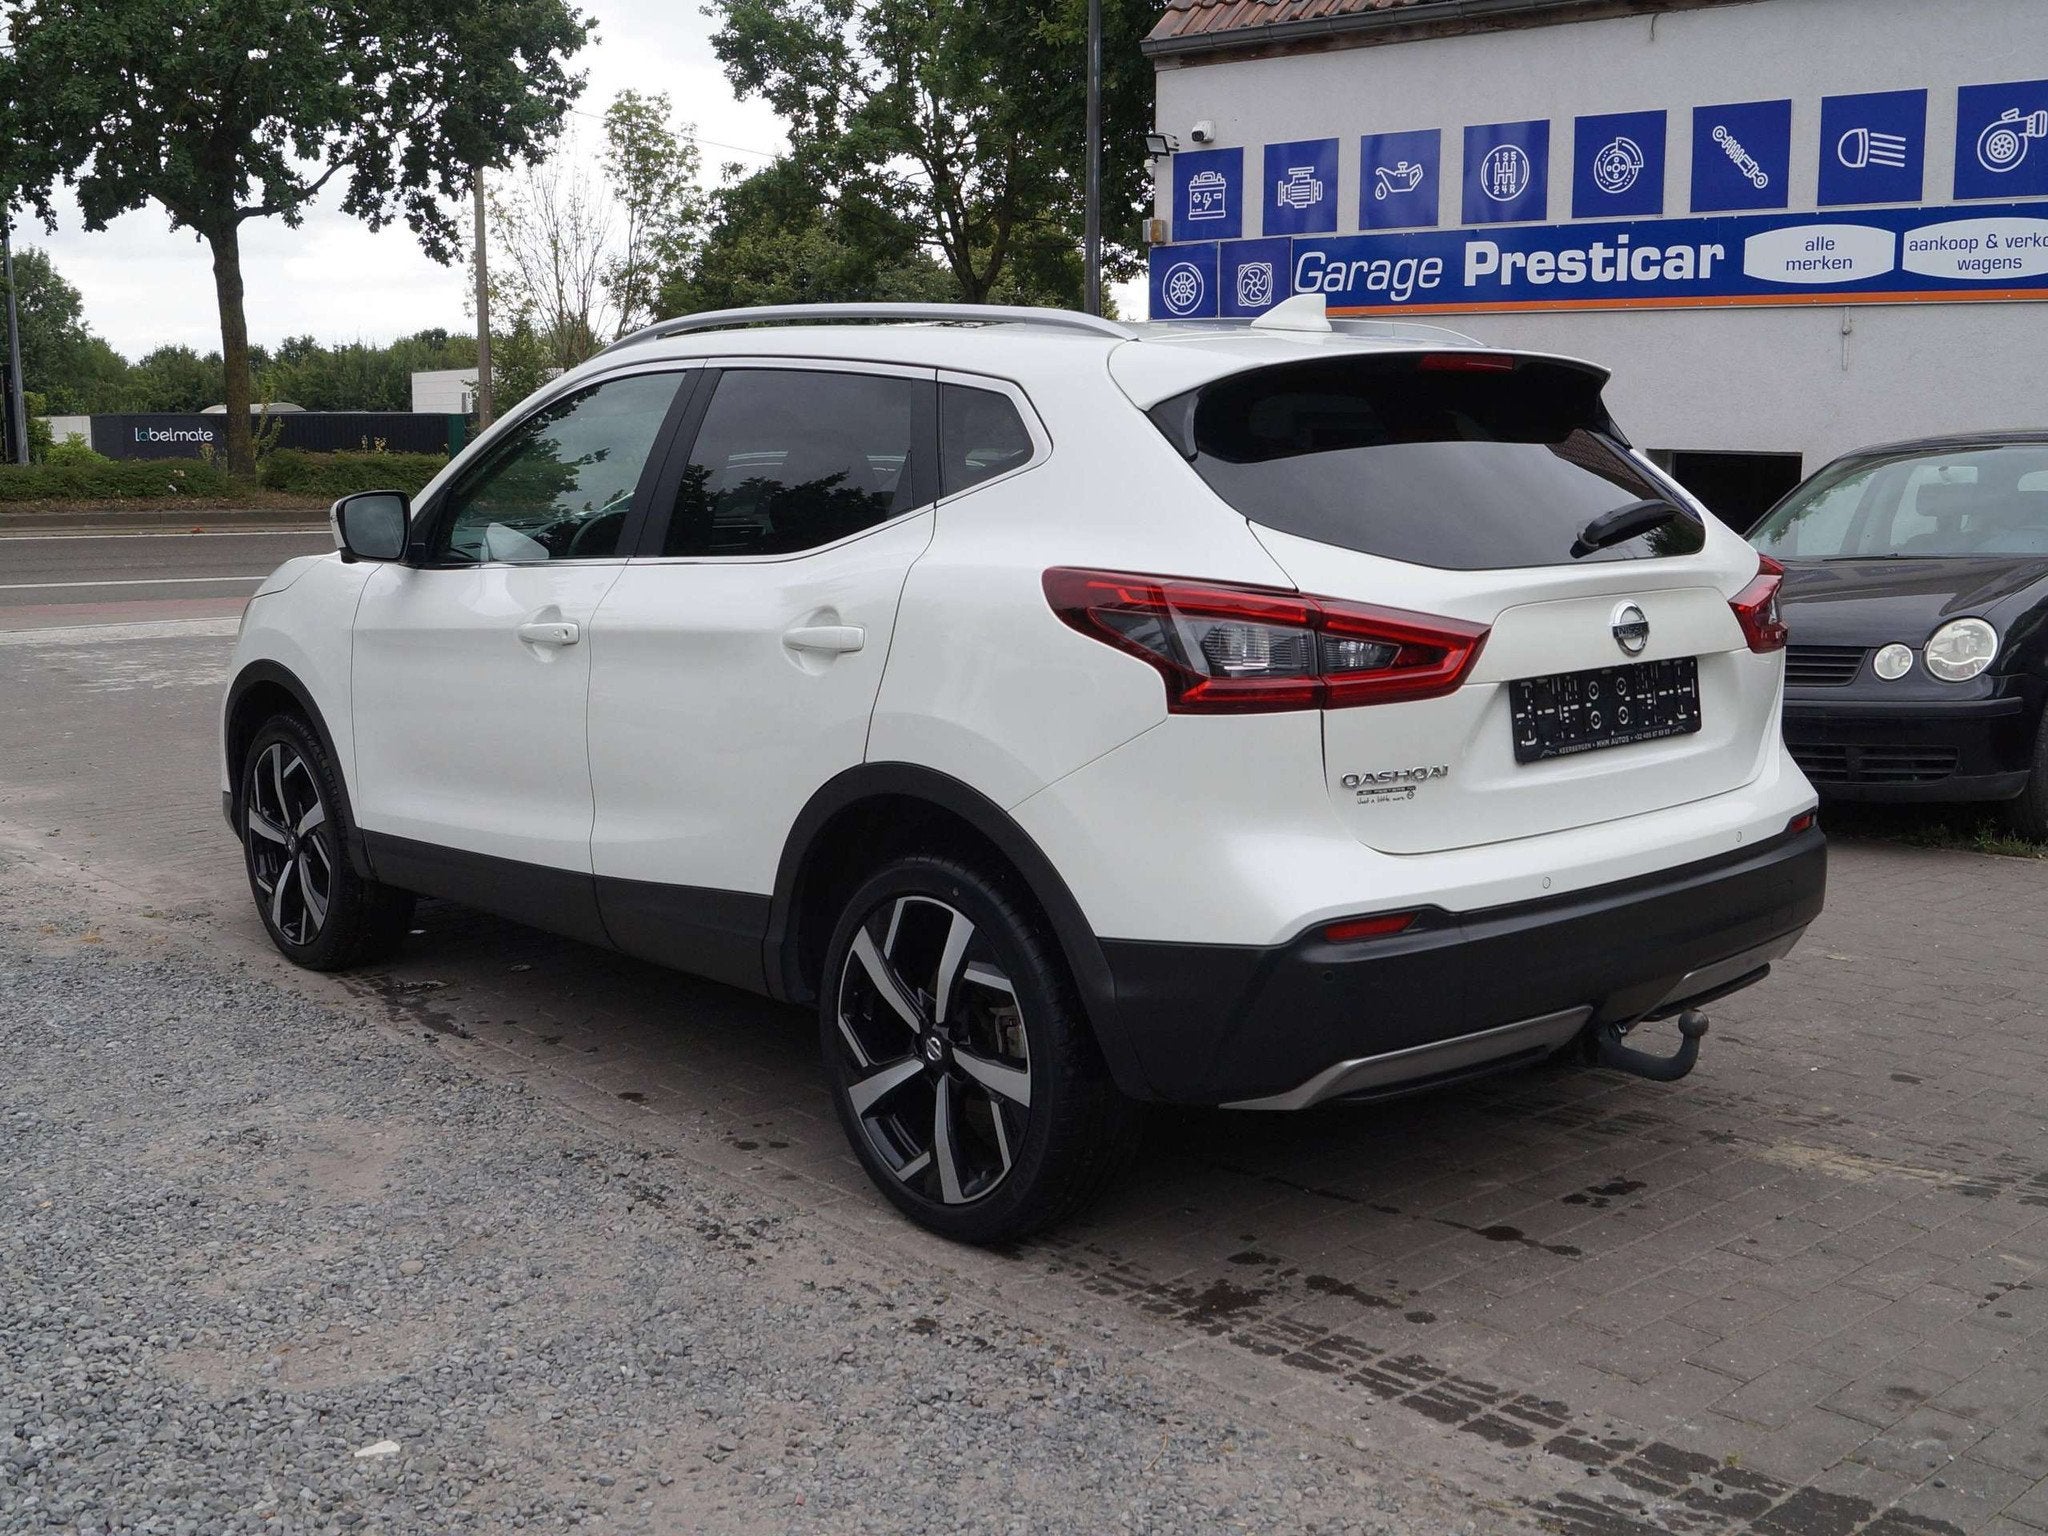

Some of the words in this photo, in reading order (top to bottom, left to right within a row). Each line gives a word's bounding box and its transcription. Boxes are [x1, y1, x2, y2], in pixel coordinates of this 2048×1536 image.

[1804, 236, 1836, 252] alle
[1908, 234, 1979, 254] aankoop
[1985, 233, 1999, 249] &
[1293, 250, 1444, 302] Garage
[1464, 233, 1725, 288] Presticar
[1785, 255, 1853, 272] merken
[1956, 257, 2023, 275] wagens
[134, 427, 214, 442] labelmate
[1339, 763, 1449, 789] QASHQAI
